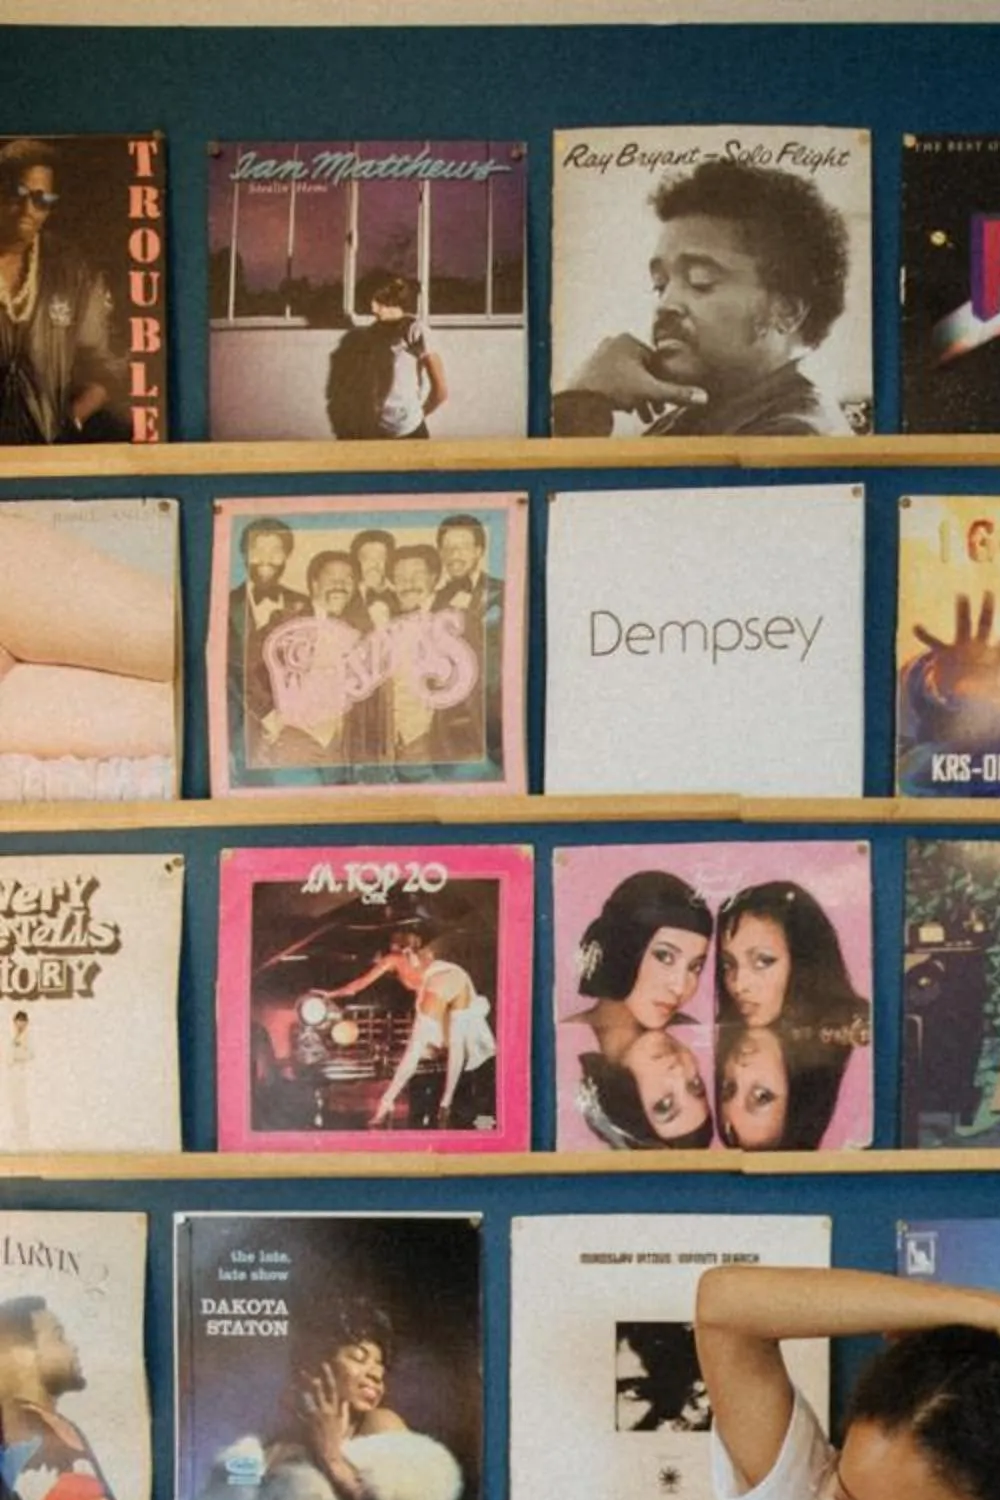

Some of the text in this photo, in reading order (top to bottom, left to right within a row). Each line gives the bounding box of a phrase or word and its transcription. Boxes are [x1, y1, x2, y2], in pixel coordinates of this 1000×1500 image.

[311, 147, 512, 185] Matthews
[563, 143, 613, 174] Ray
[615, 142, 701, 173] Bryant
[719, 139, 774, 166] Solo
[776, 142, 851, 174] Flight
[127, 140, 161, 444] TROUBLE
[589, 609, 823, 664] Dempsey
[402, 862, 449, 893] 20
[230, 1249, 256, 1264] the
[217, 1267, 289, 1281] late show
[200, 1298, 289, 1316] DAKOTA
[206, 1319, 289, 1337] STATON
